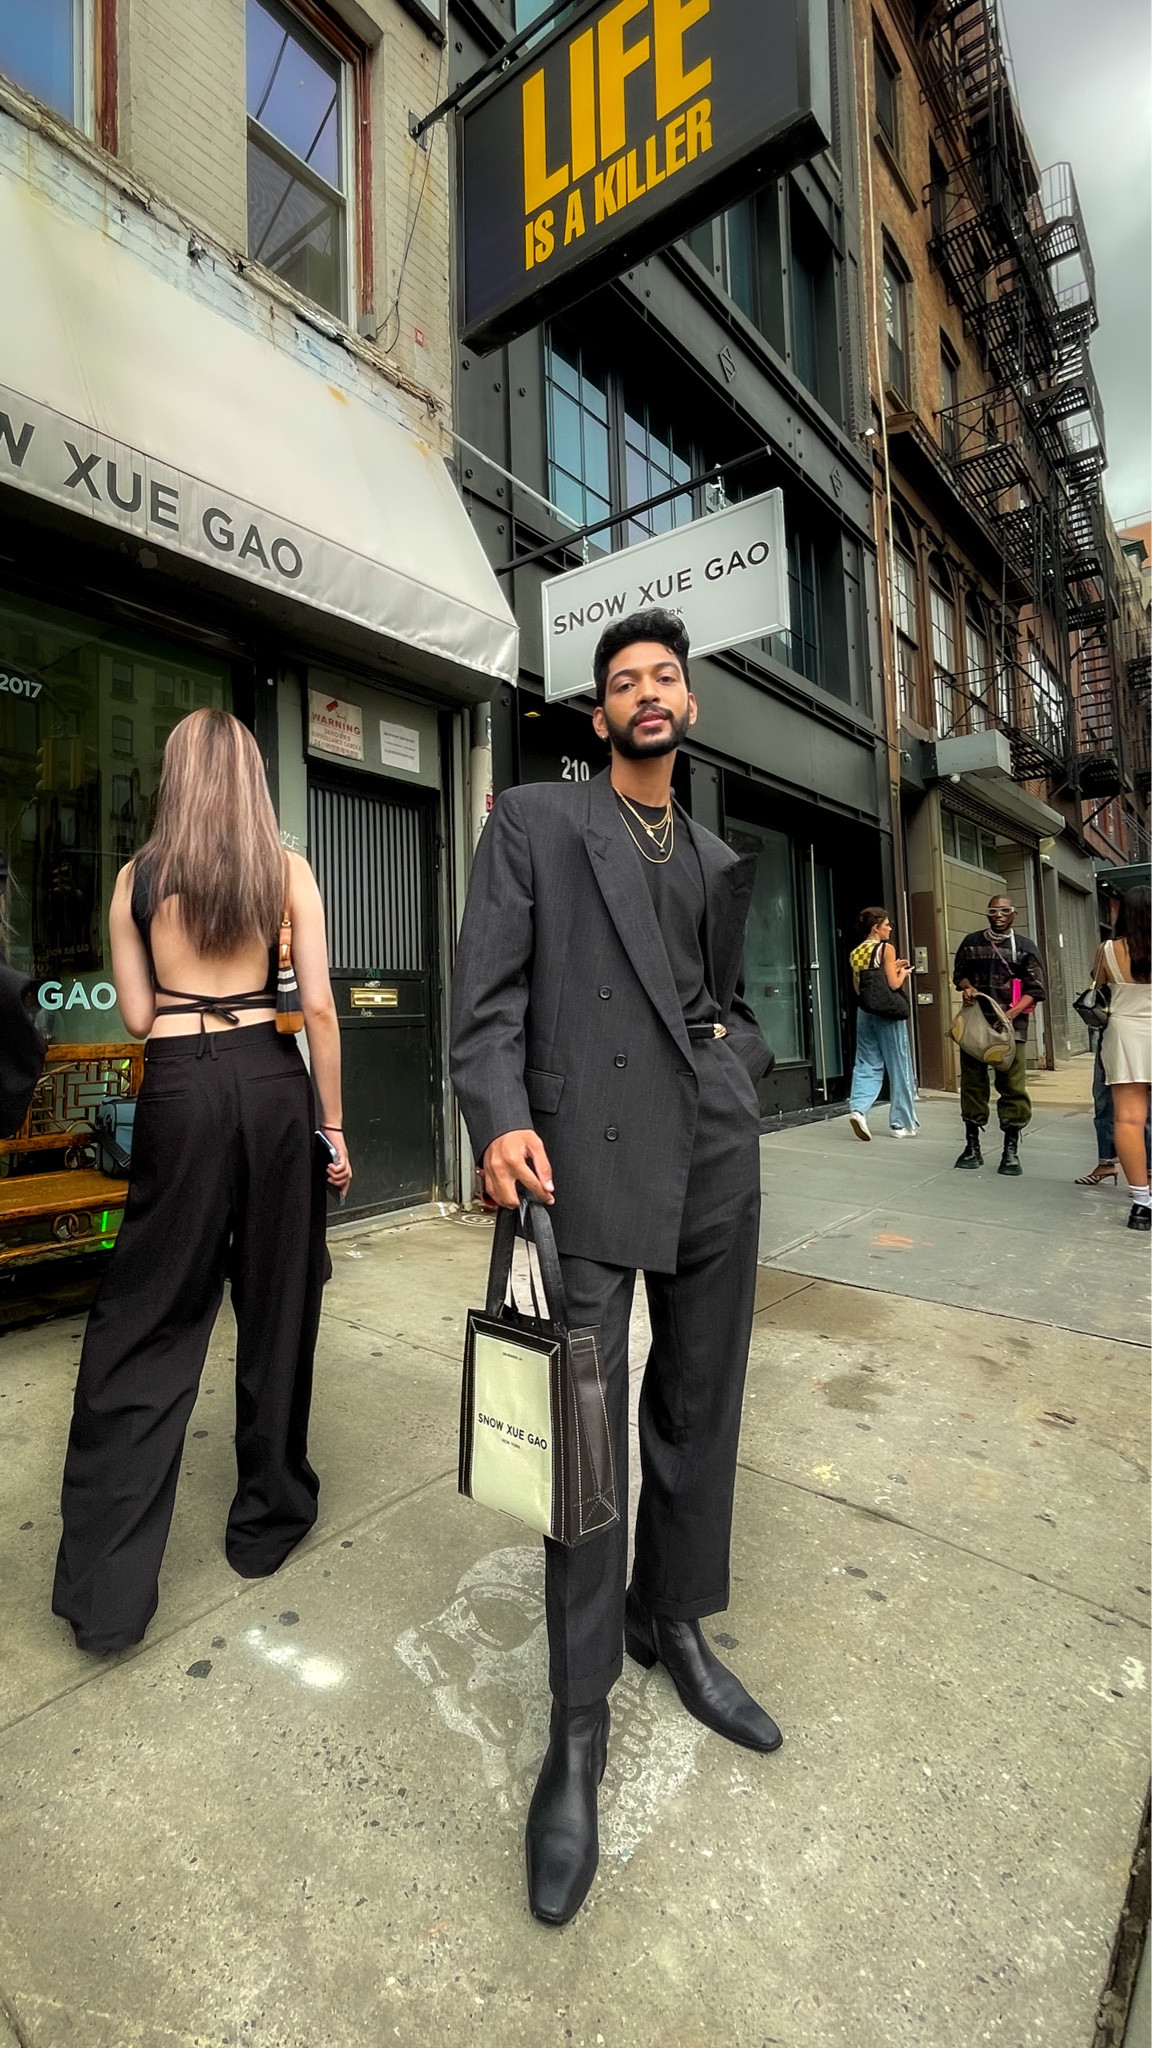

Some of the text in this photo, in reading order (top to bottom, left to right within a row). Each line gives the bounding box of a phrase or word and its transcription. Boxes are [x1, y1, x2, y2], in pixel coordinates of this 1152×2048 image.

[522, 0, 713, 216] LIFE
[525, 98, 713, 271] IS A KILLER
[62, 440, 180, 532] XUE
[202, 507, 303, 579] GAO
[553, 541, 770, 636] SNOW XUE GAO
[0, 673, 43, 698] 2017
[311, 711, 361, 735] WARNING
[561, 756, 590, 783] 210
[37, 981, 117, 1010] GAO
[477, 1412, 548, 1450] SNOW XUE GAO
